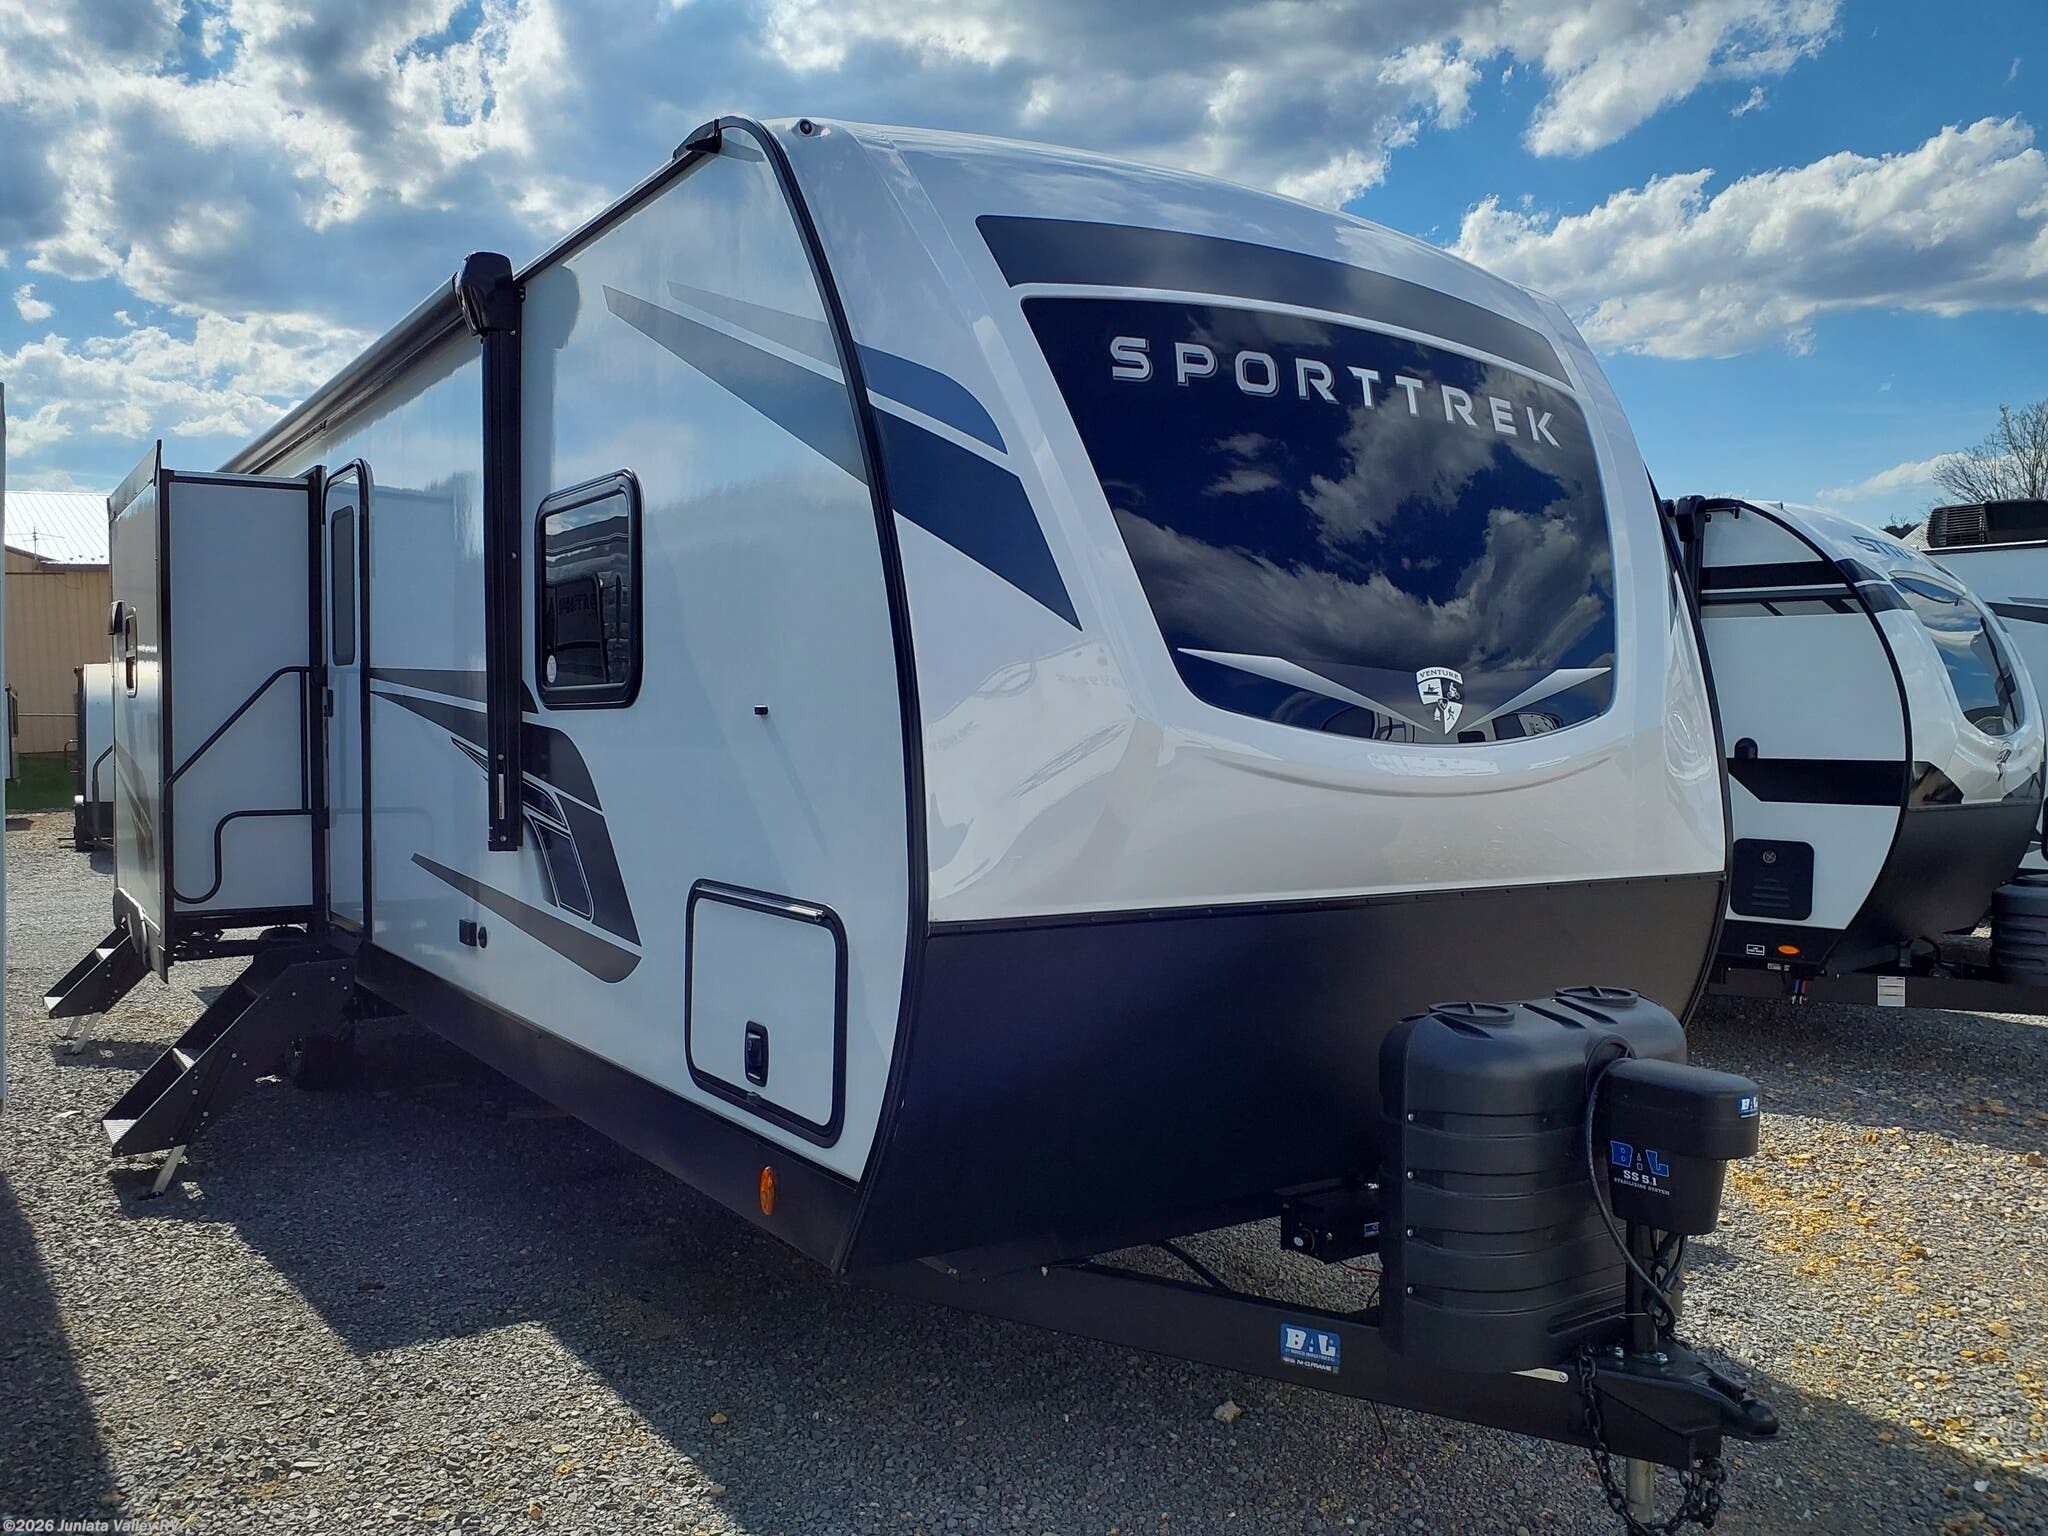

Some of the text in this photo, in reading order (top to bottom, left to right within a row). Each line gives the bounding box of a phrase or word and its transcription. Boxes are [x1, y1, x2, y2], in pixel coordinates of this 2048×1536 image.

[1109, 336, 1562, 448] SPORTTREK
[1419, 669, 1461, 681] VENTURE
[1610, 1140, 1670, 1178] BAL
[1623, 1169, 1658, 1187] SS 5.1
[1648, 1185, 1671, 1196] SYSTEM
[1286, 1328, 1336, 1357] BAL
